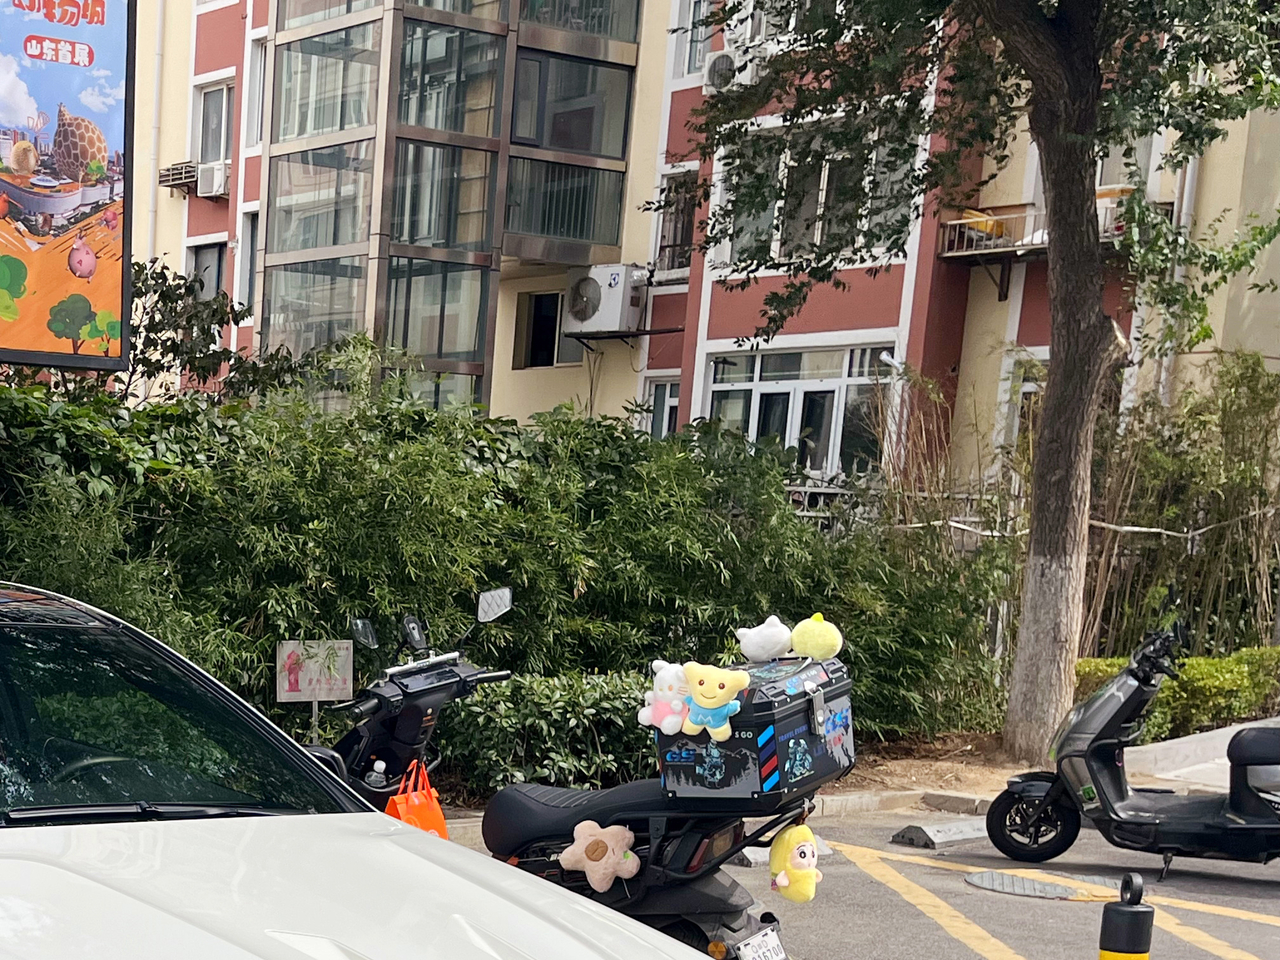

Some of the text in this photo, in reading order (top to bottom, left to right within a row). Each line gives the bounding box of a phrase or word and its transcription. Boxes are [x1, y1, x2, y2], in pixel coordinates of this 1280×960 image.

[26, 39, 90, 67] 山东首展
[740, 731, 754, 739] GO
